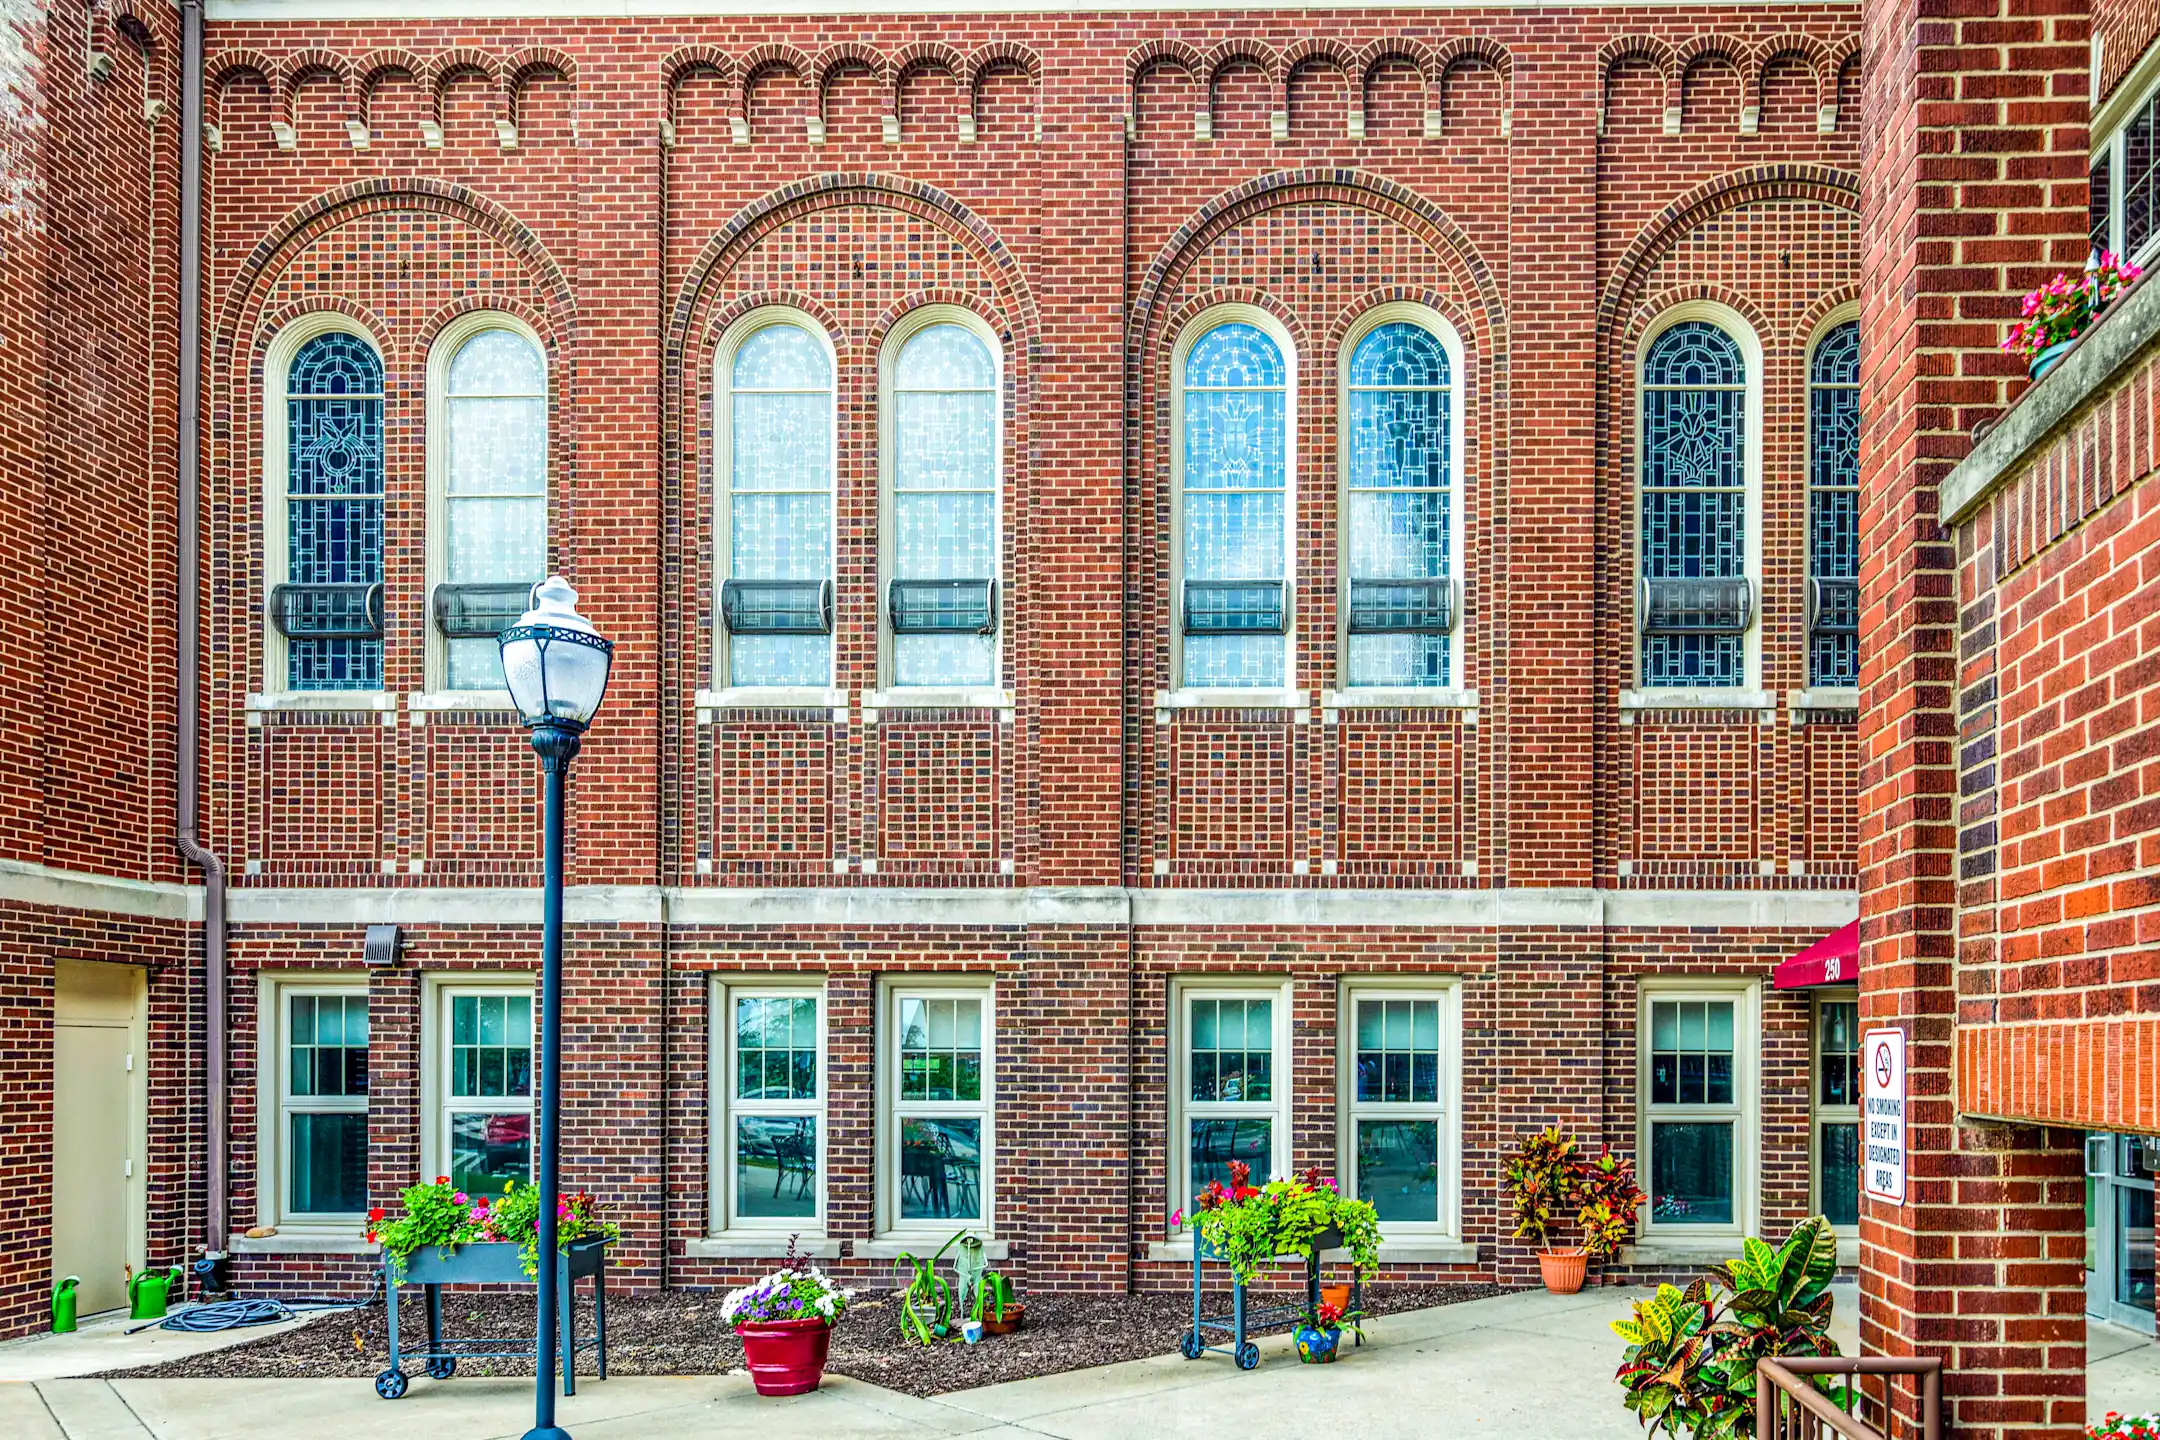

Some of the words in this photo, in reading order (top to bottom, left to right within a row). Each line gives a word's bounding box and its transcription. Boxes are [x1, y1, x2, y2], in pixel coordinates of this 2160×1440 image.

[1825, 957, 1840, 981] 250
[1868, 1098, 1875, 1114] NO
[1876, 1098, 1901, 1117] SMOKING
[1871, 1121, 1890, 1140] EXCEPT
[1891, 1123, 1898, 1140] IN
[1868, 1144, 1900, 1166] DESIGNATED
[1875, 1169, 1893, 1189] AREAS
